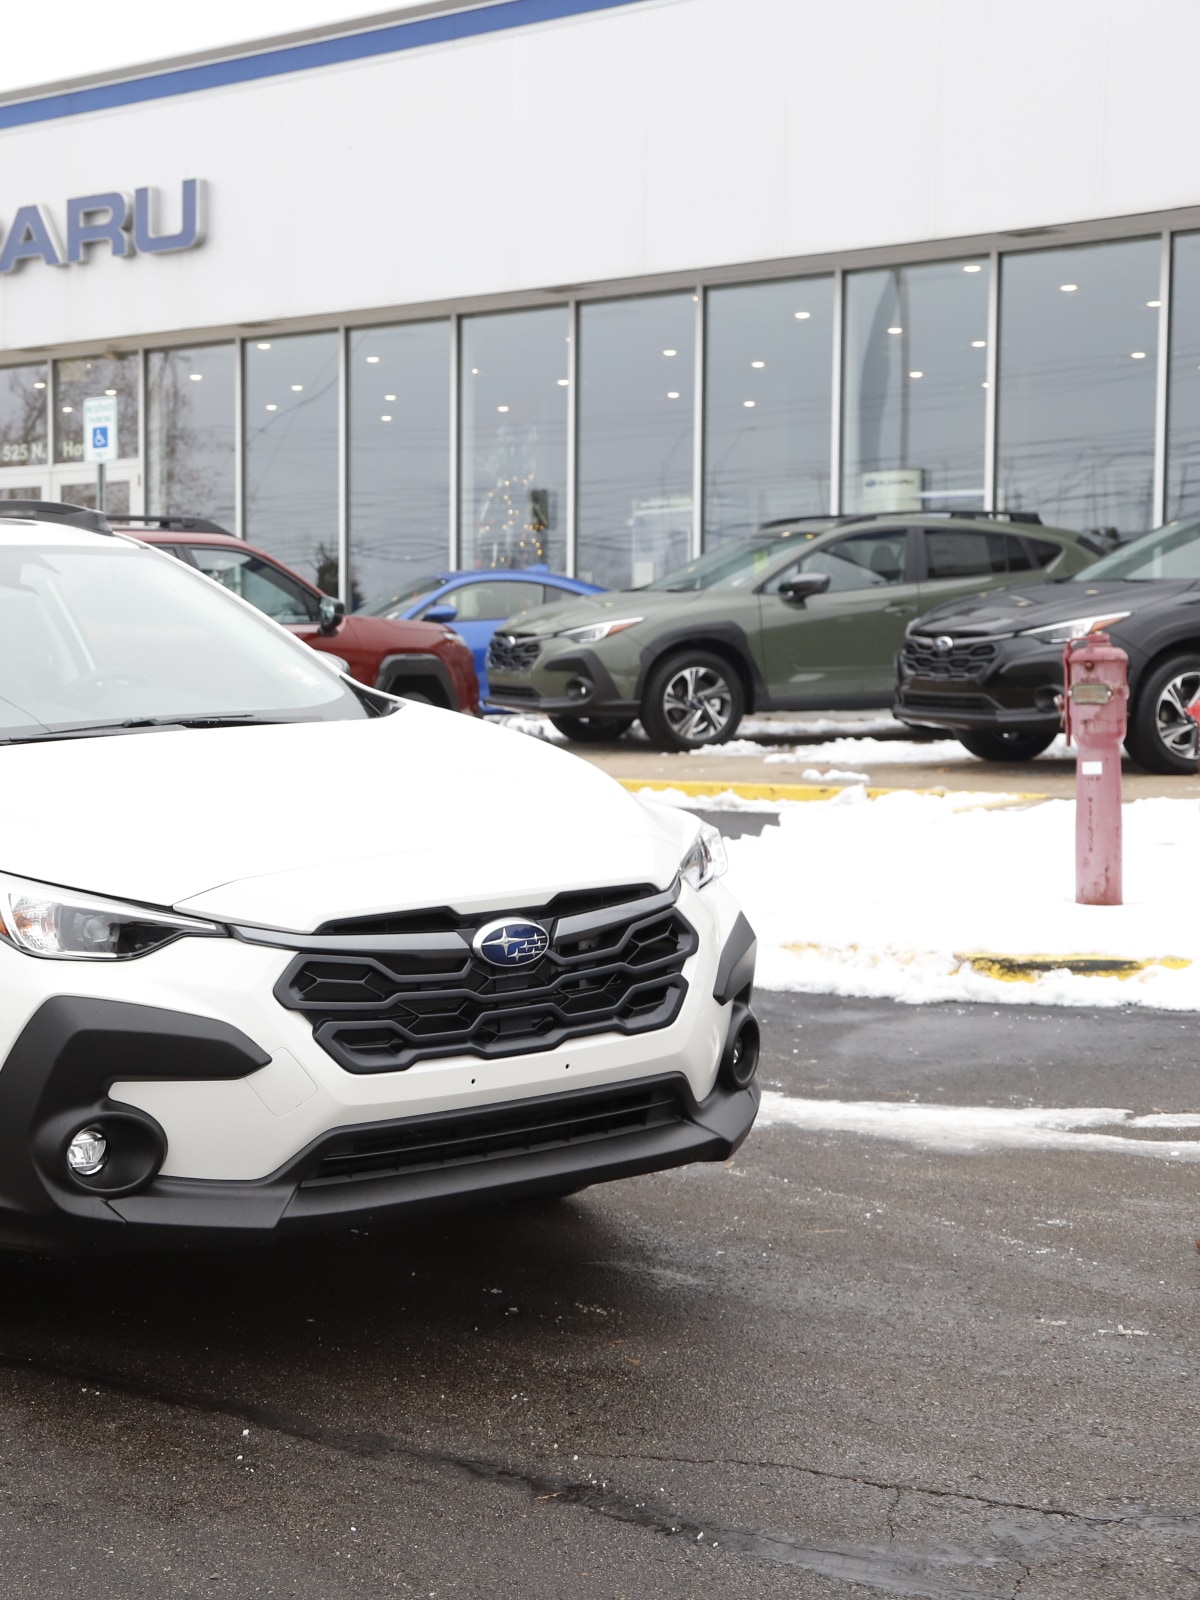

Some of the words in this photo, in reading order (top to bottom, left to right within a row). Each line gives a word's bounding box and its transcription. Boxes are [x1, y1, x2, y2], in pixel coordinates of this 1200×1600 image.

[3, 444, 28, 461] 525
[31, 443, 46, 458] N.
[62, 441, 84, 457] Ho
